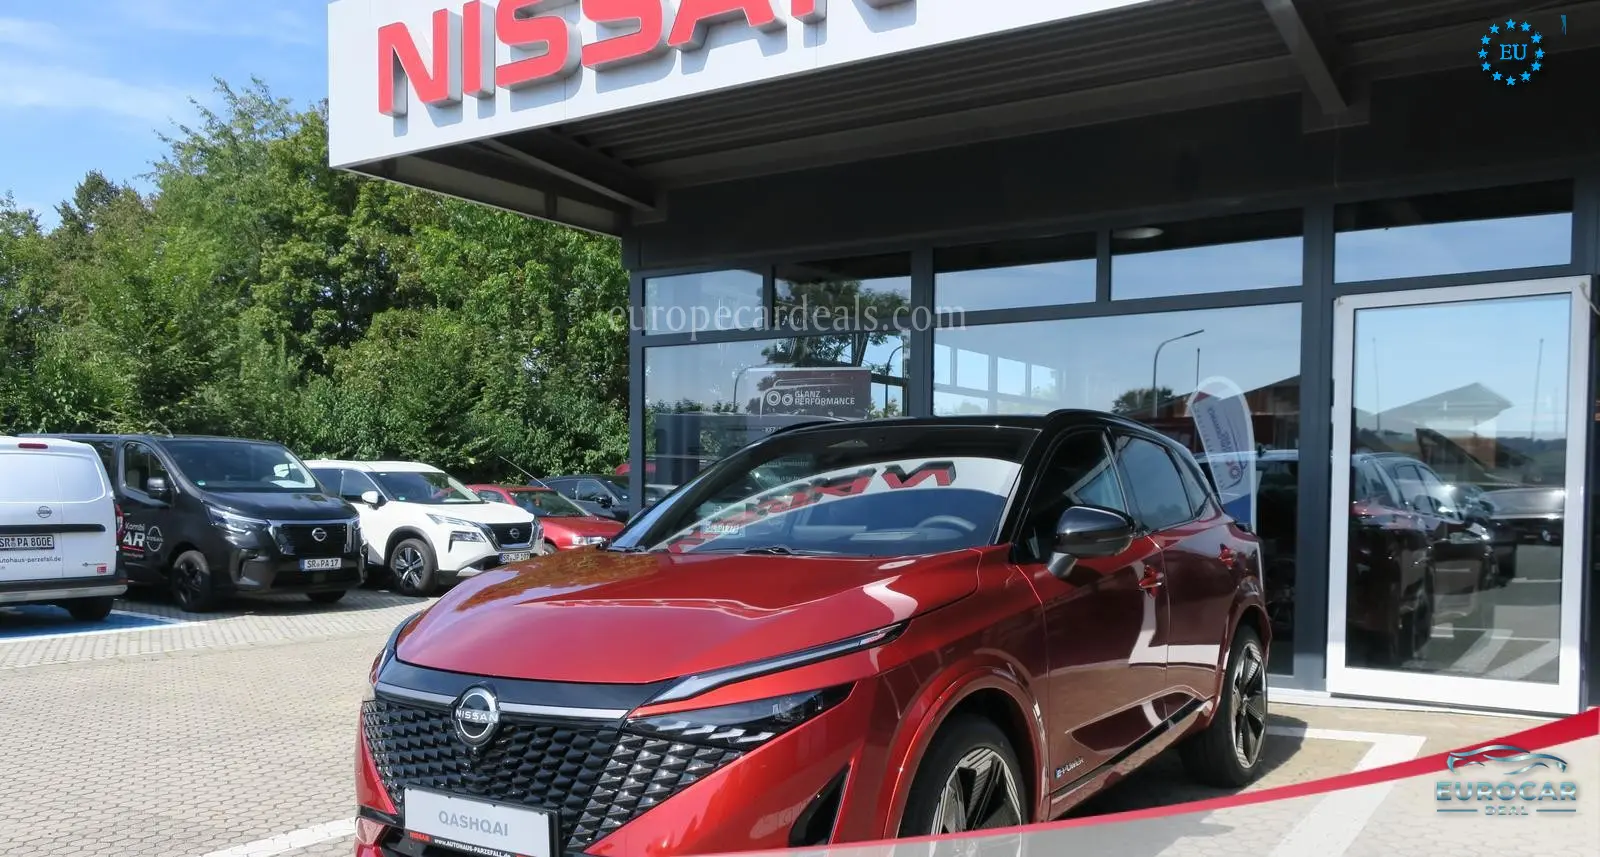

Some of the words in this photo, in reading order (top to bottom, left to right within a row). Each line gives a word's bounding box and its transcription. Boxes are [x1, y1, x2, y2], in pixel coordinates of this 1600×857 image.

[378, 0, 919, 117] NISS
[795, 390, 821, 398] GLANZ
[795, 398, 855, 406] PERFORMANCE
[17, 537, 29, 547] PA
[30, 536, 52, 547] 800E
[122, 531, 146, 547] AR
[307, 560, 317, 568] SR
[320, 559, 330, 567] PA
[331, 558, 338, 567] 17
[456, 709, 499, 722] NISSAN
[438, 809, 509, 837] QASHQAI
